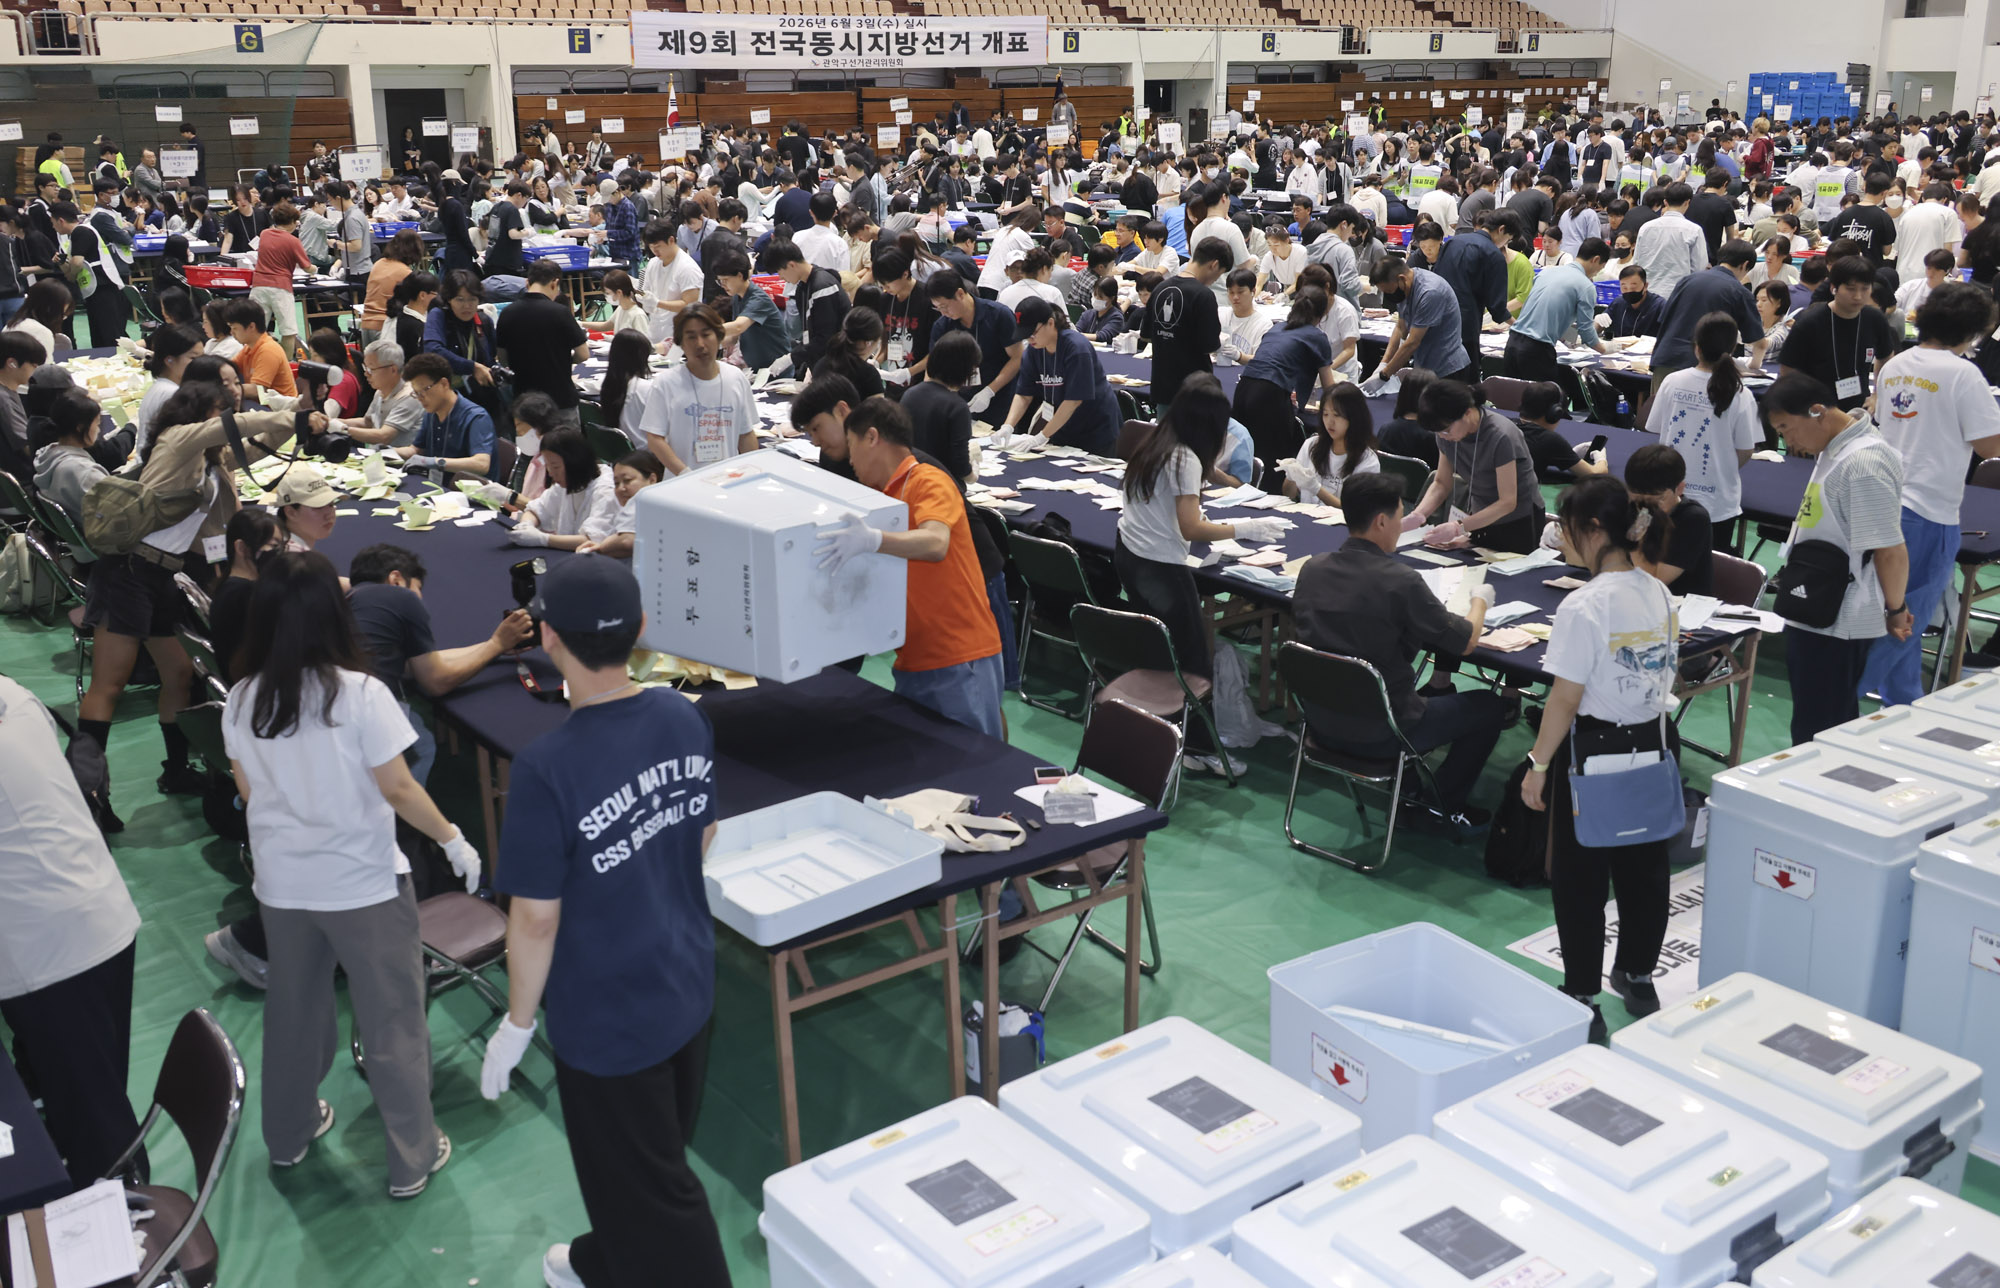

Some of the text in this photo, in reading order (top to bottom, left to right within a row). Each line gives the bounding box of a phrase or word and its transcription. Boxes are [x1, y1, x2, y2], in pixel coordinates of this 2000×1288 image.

[778, 17, 928, 29] 2026년 6월 3일(수) 실시
[240, 31, 258, 50] G
[574, 34, 585, 51] F
[657, 29, 1029, 56] 제9회 전국동시지방선거 개표
[1066, 37, 1076, 51] D
[1264, 37, 1273, 51] C
[1432, 38, 1440, 50] B
[1529, 38, 1537, 50] A
[1684, 482, 1716, 493] ercredi
[578, 783, 638, 841] SEOUL
[591, 839, 632, 874] CSS
